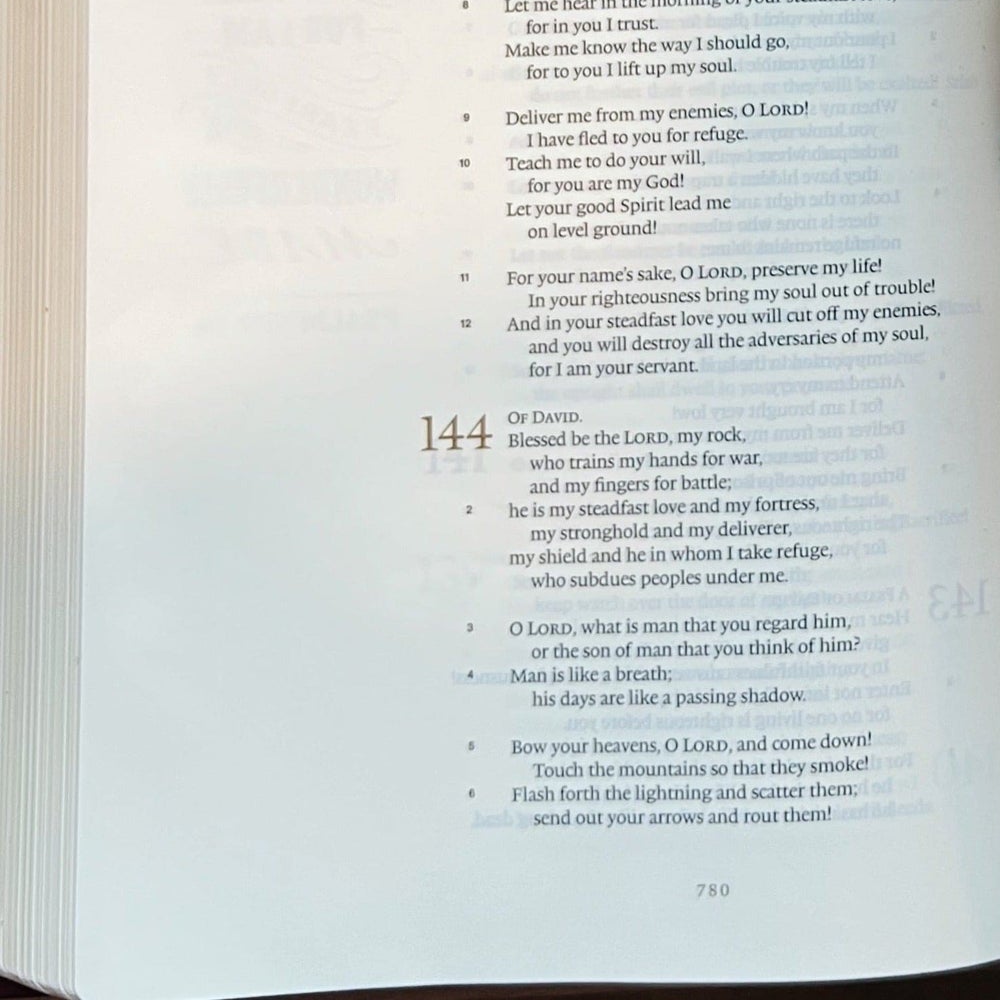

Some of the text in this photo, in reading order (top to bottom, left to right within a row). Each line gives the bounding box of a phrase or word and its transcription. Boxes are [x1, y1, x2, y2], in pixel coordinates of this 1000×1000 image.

[462, 0, 469, 10] 8
[505, 0, 529, 13] Let
[534, 0, 558, 12] me
[463, 113, 470, 122] 9
[506, 110, 563, 125] Deliver
[567, 112, 592, 123] me
[596, 107, 635, 122] from
[640, 110, 665, 124] my
[668, 103, 738, 120] enemies,
[741, 103, 755, 117] O
[760, 101, 809, 117] LORD!
[460, 258, 882, 288] 11 For your name's sake, O LORD, preserve my life!
[460, 304, 941, 333] 12 And in your steadfast love you will cut off my enemies,
[508, 411, 584, 424] OF DAVID.
[420, 413, 493, 452] 144
[509, 426, 746, 448] Blessed be the LORD, my rock,
[466, 496, 819, 520] 2 he is my steadfast love and my fortress,
[467, 666, 672, 683] 4 Man is like a breath;
[468, 731, 872, 757] 5 Bow your heavens, O LORD, and come down!
[696, 883, 730, 897] 780
